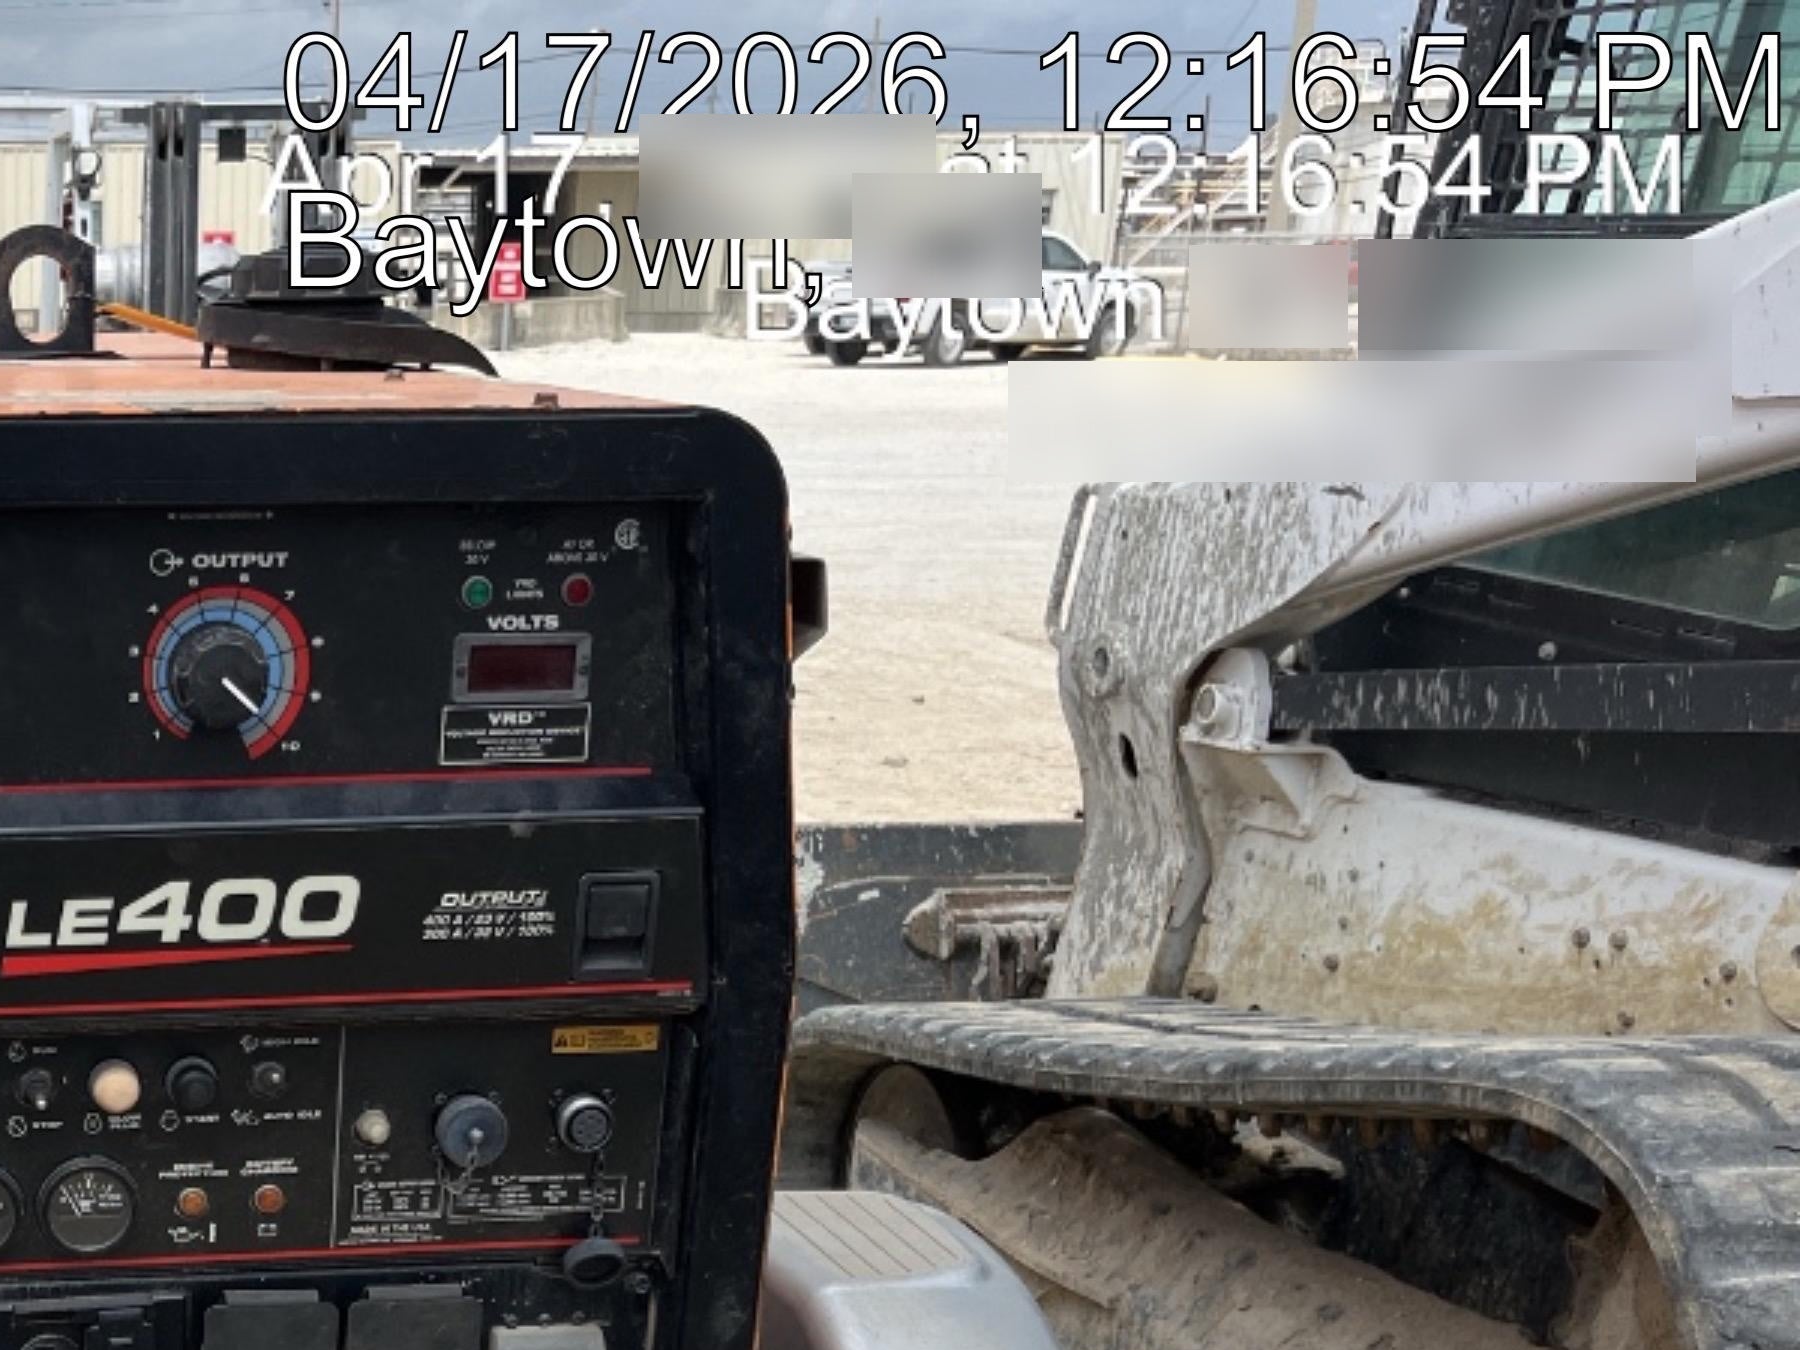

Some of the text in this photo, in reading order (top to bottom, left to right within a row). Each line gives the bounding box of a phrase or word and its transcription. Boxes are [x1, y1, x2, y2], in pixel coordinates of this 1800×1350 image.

[193, 552, 289, 568] OUTPUT
[487, 614, 560, 631] VOLTS
[5, 875, 361, 949] LE400
